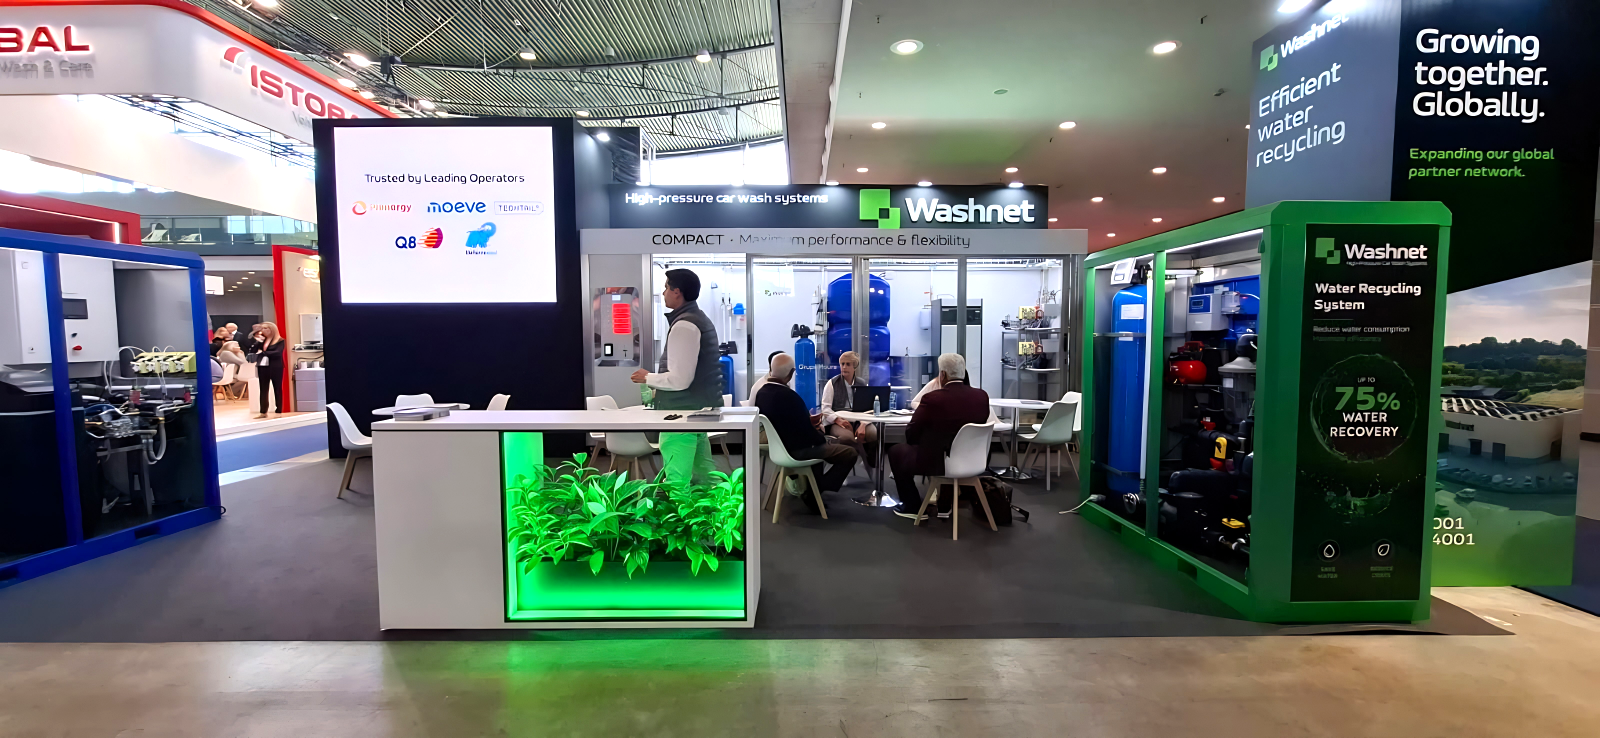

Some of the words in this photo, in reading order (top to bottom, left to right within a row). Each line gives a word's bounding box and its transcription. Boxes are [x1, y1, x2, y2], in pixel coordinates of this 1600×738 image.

[1280, 11, 1350, 58] Washnet
[1415, 28, 1540, 61] Growing
[1415, 60, 1549, 91] together.
[250, 64, 359, 119] ISTOB
[1258, 62, 1341, 118] Efficient
[1412, 91, 1546, 123] Globally.
[1257, 105, 1314, 142] water
[1256, 120, 1346, 168] recycling
[1409, 148, 1483, 162] Expanding
[1486, 151, 1510, 160] our
[1512, 147, 1555, 162] global
[365, 173, 405, 183] Trusted
[407, 173, 422, 185] by
[424, 173, 467, 185] Leading
[469, 173, 525, 185] Operators
[1408, 166, 1461, 180] partner
[1464, 166, 1526, 178] network.
[625, 193, 714, 206] High-pressure
[716, 194, 734, 203] car
[737, 193, 772, 203] wash
[774, 193, 829, 206] systems
[427, 202, 487, 213] moeve
[905, 197, 1035, 223] Washnet
[394, 236, 417, 249] Q8
[652, 234, 725, 246] COMPACT
[739, 233, 805, 246] Maximm
[808, 233, 894, 248] performance
[897, 234, 907, 246] &
[911, 233, 971, 248] flexibility
[1344, 243, 1428, 260] Washnet
[1315, 283, 1356, 294] Water
[1358, 282, 1422, 297] Recycling
[1314, 299, 1365, 312] System
[1363, 325, 1411, 334] consumption
[1334, 386, 1401, 411] 75%
[1342, 412, 1388, 423] WATER
[1329, 426, 1399, 437] RECOVERY
[1432, 533, 1476, 546] 4001
